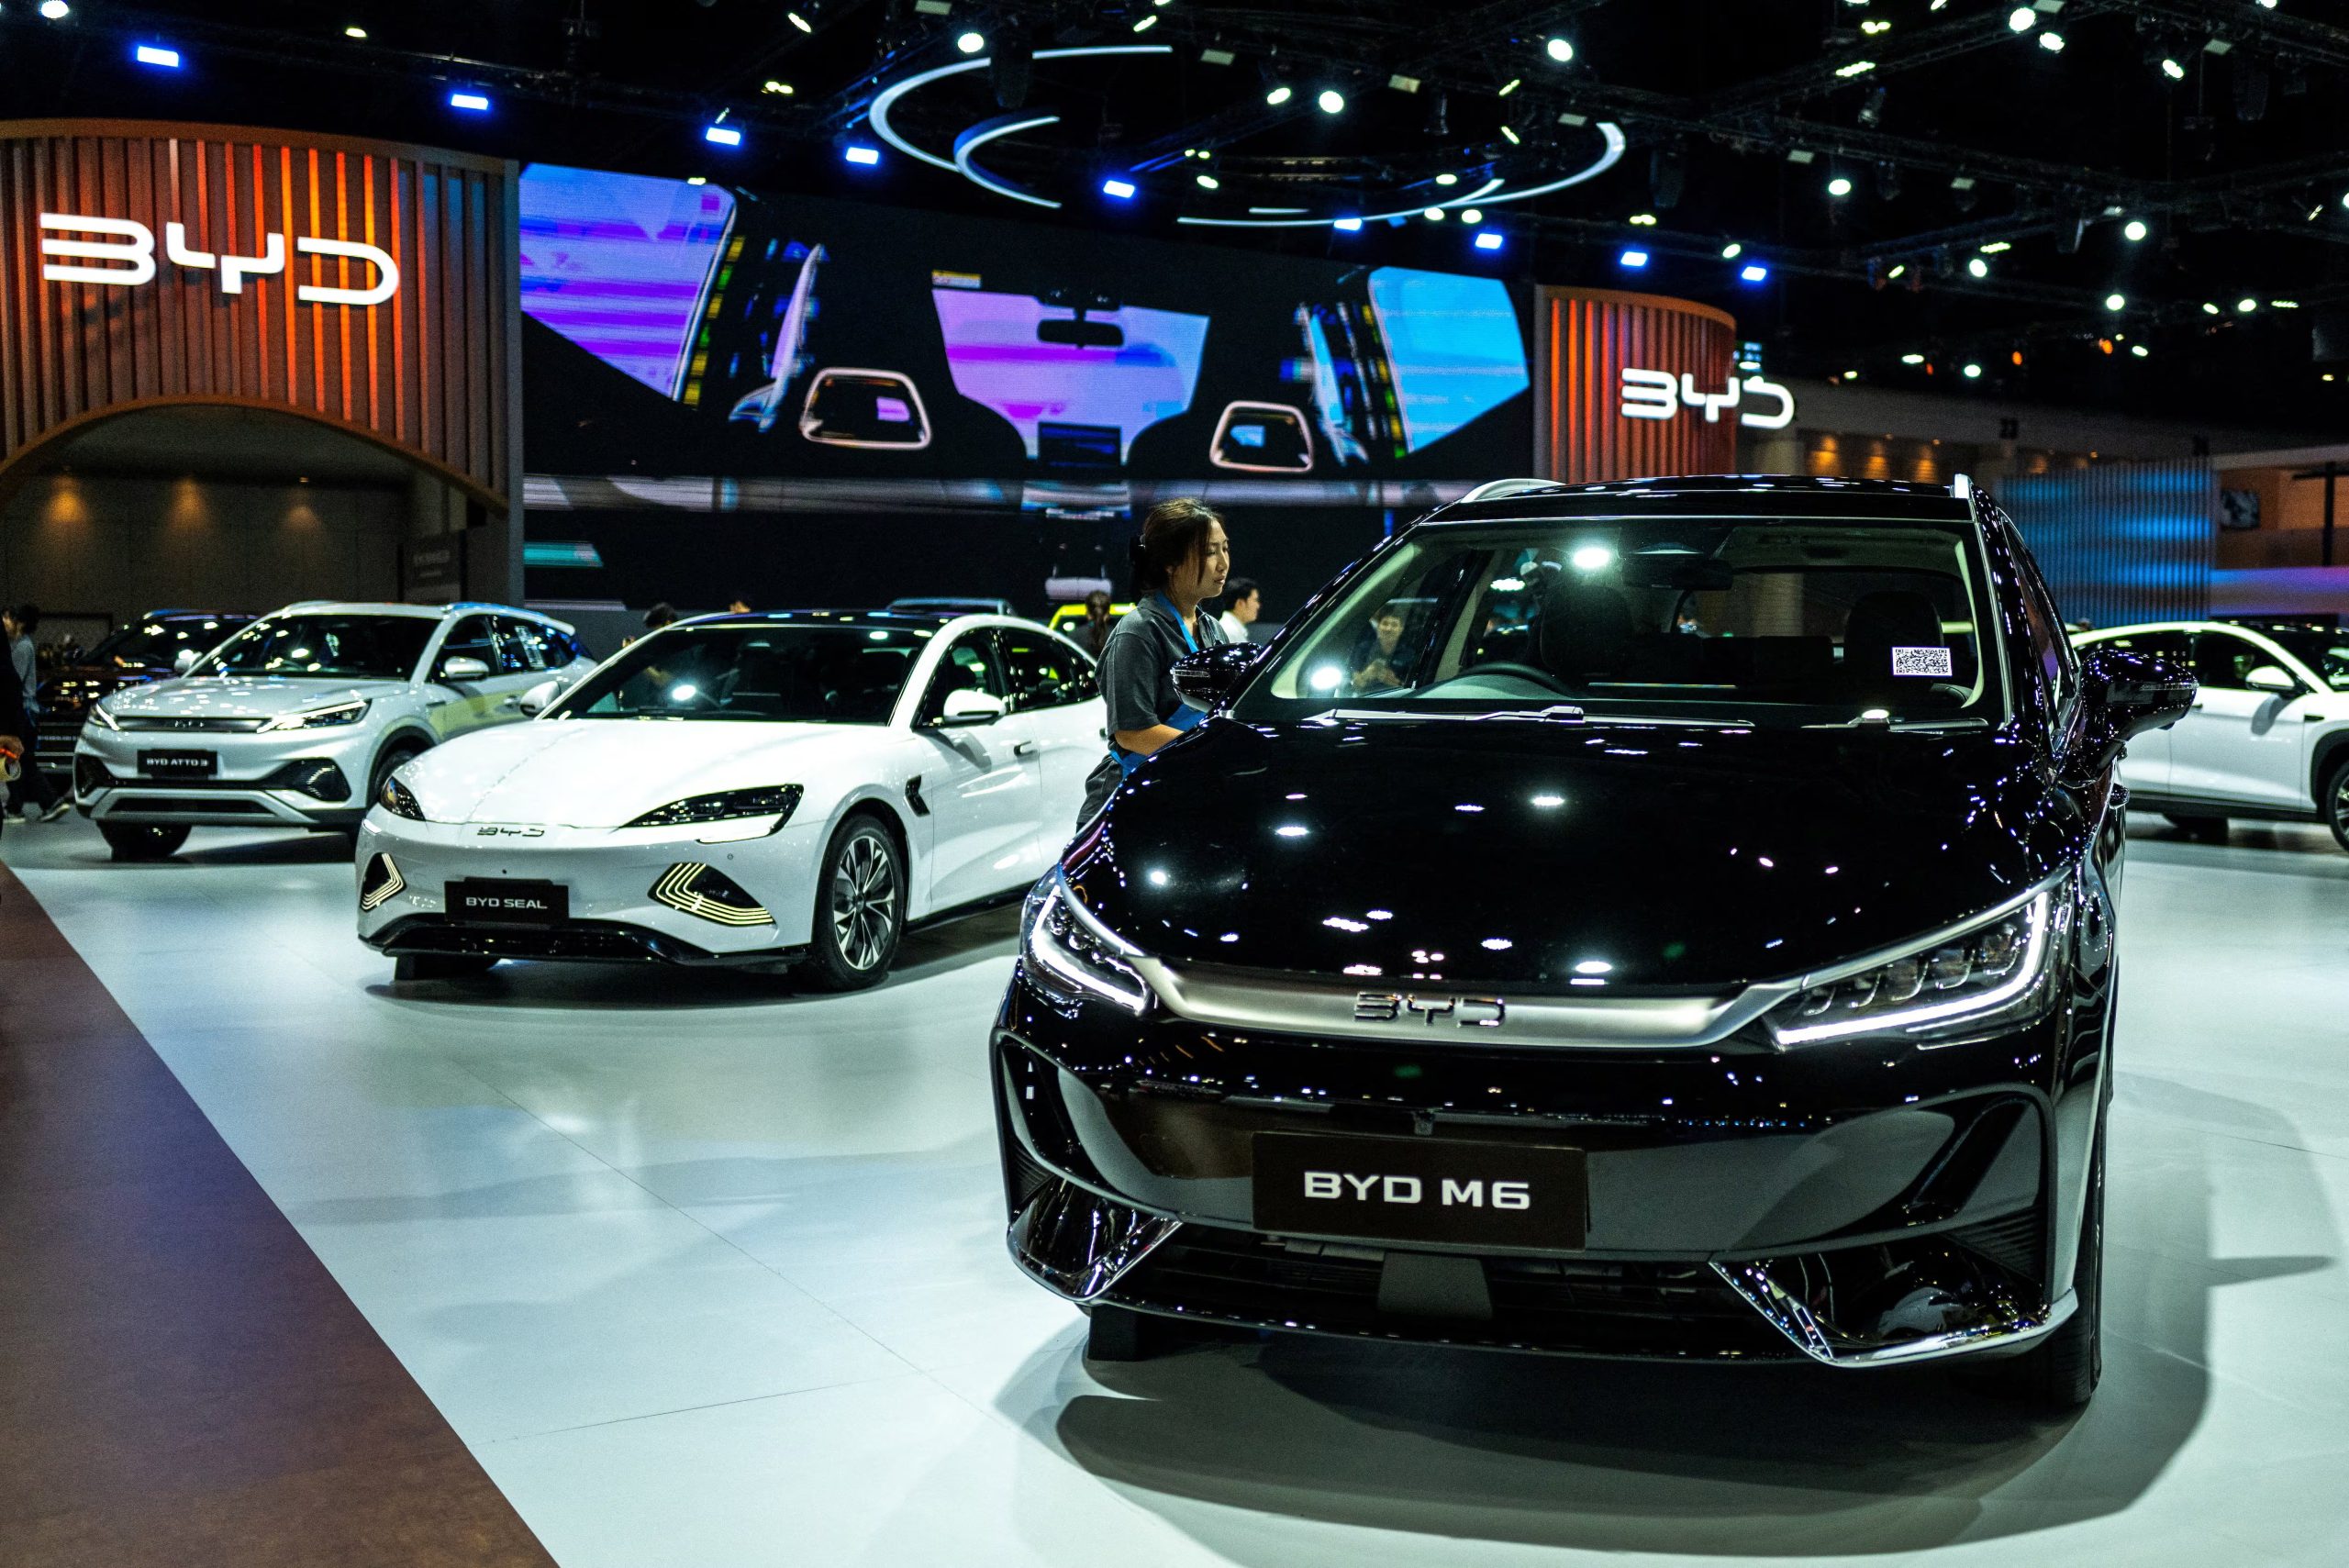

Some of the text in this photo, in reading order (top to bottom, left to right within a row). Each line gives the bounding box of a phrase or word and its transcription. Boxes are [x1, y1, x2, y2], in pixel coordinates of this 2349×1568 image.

[39, 212, 400, 306] BYD
[1621, 367, 1795, 429] BYD
[146, 758, 209, 767] BYD ATTO 3
[477, 827, 545, 838] BYD
[465, 896, 548, 909] BYD SEAL
[1354, 991, 1506, 1028] BYD
[1304, 1171, 1531, 1210] BYD M6
